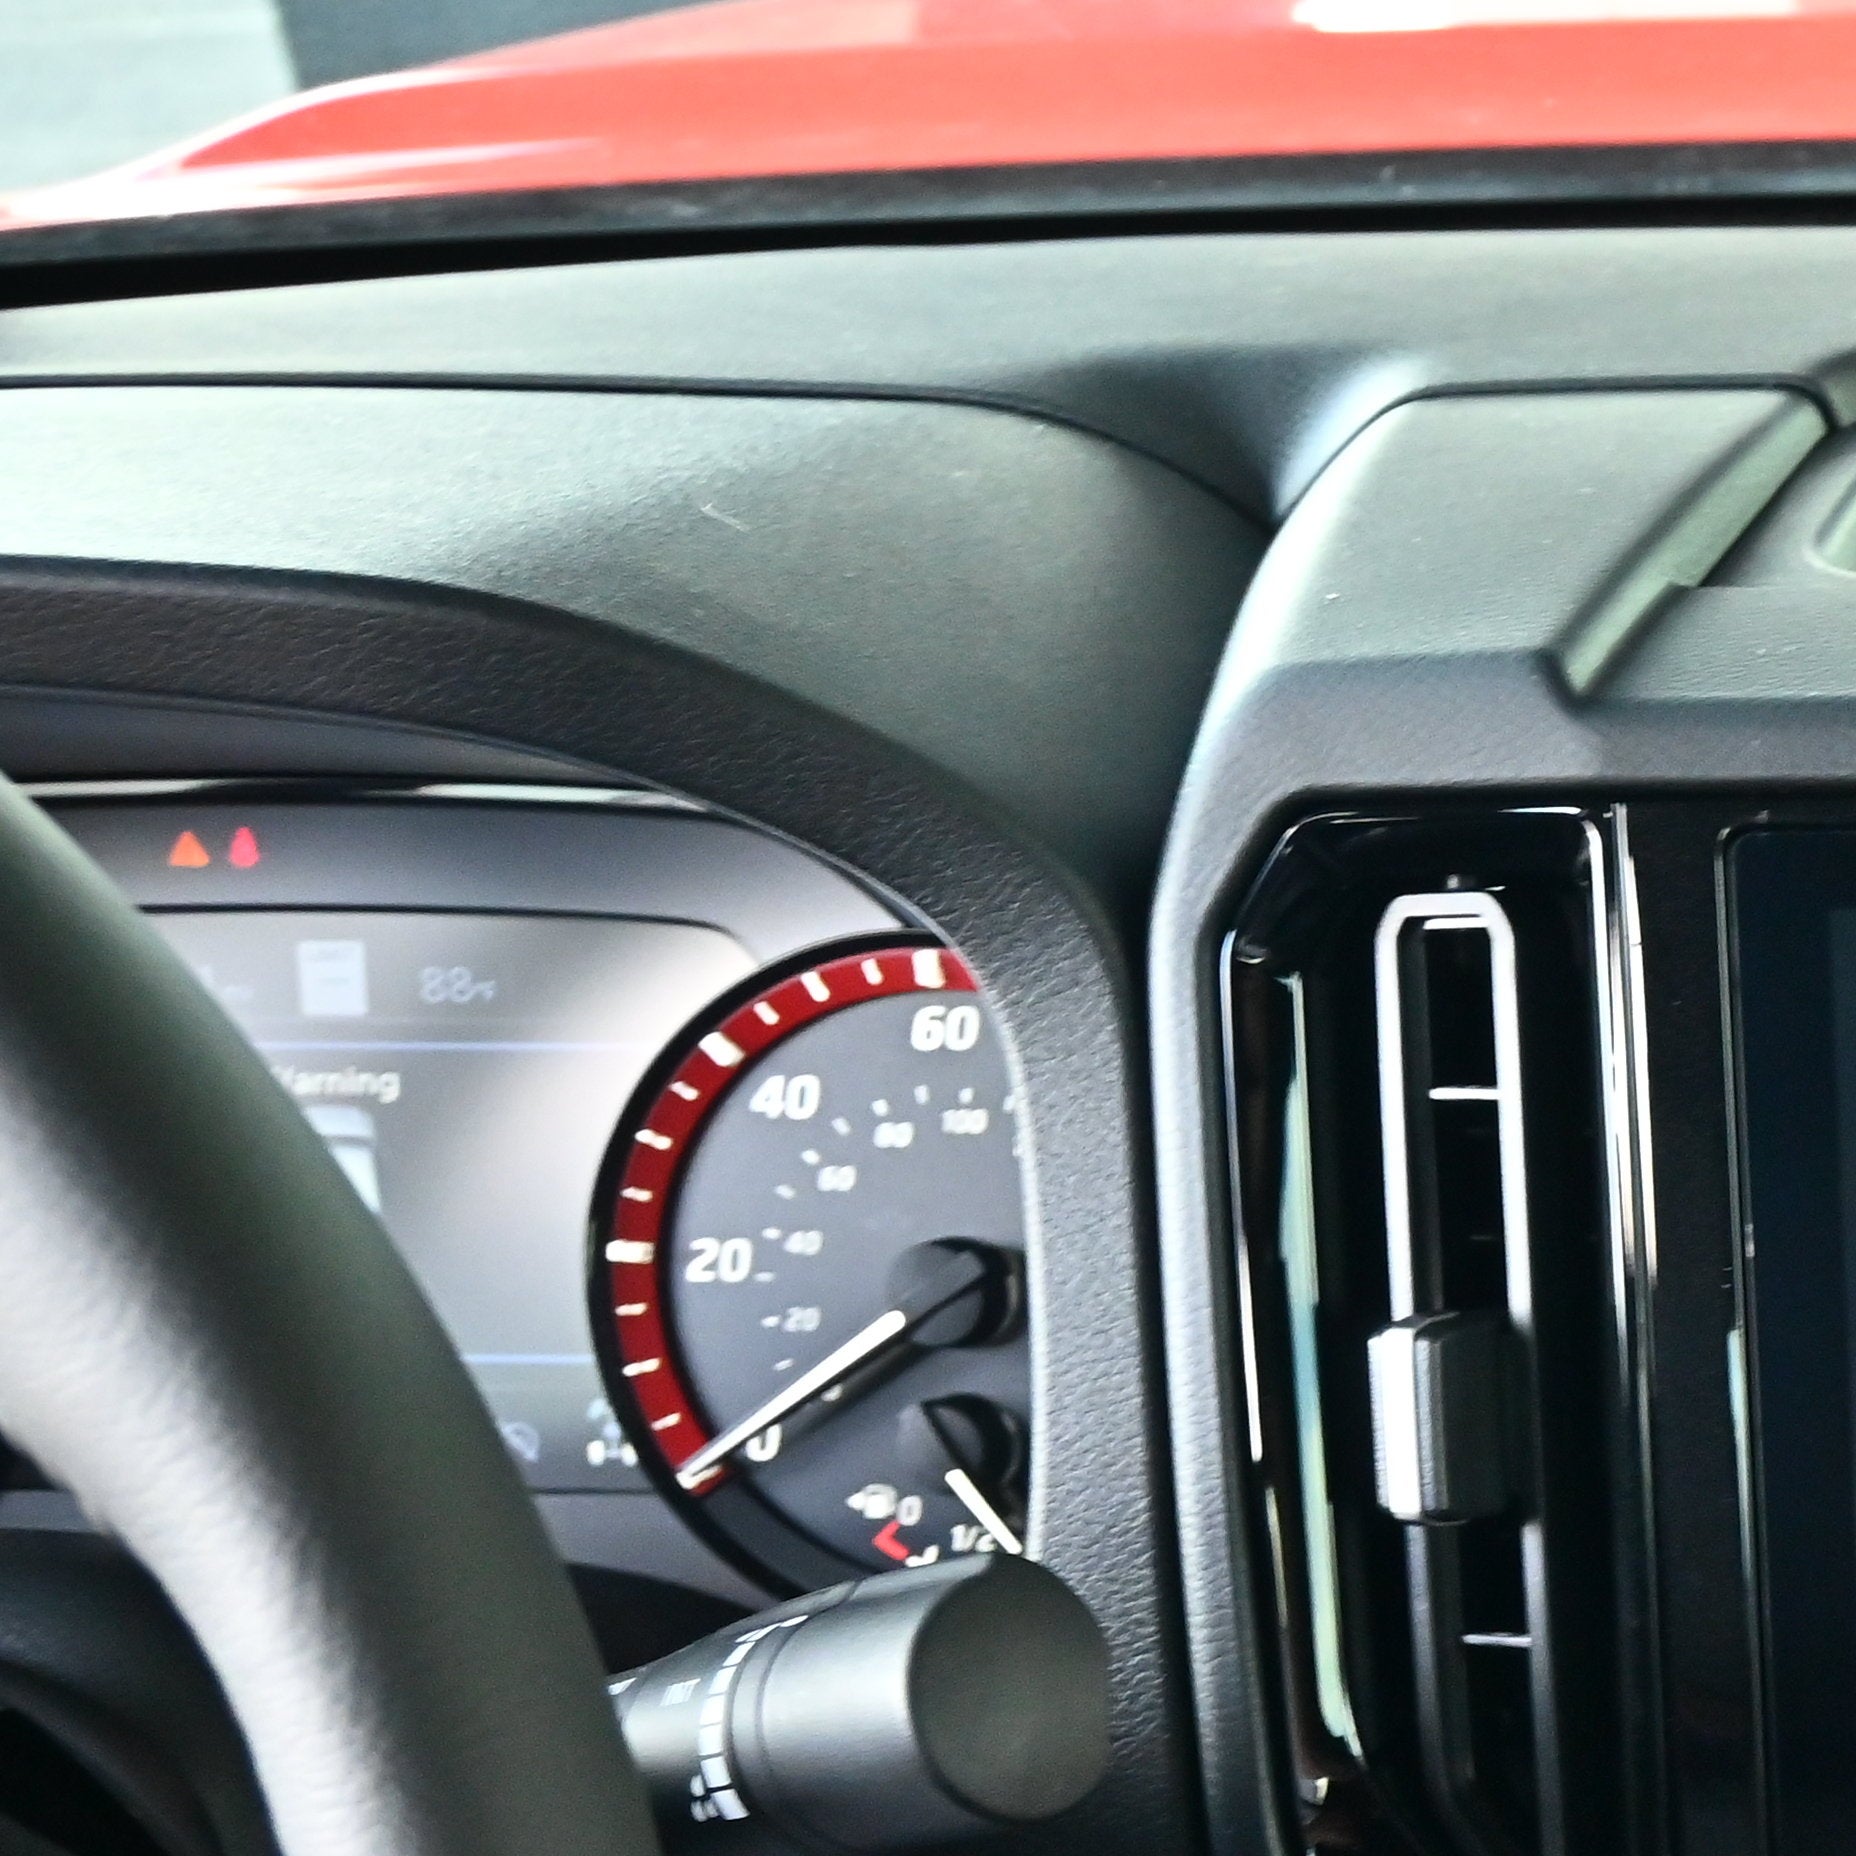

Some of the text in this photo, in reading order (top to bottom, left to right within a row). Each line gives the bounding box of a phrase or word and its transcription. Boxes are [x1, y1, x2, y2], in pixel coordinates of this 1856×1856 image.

[910, 1004, 981, 1052] 60
[748, 1074, 821, 1120] 40
[684, 1236, 753, 1284] 20
